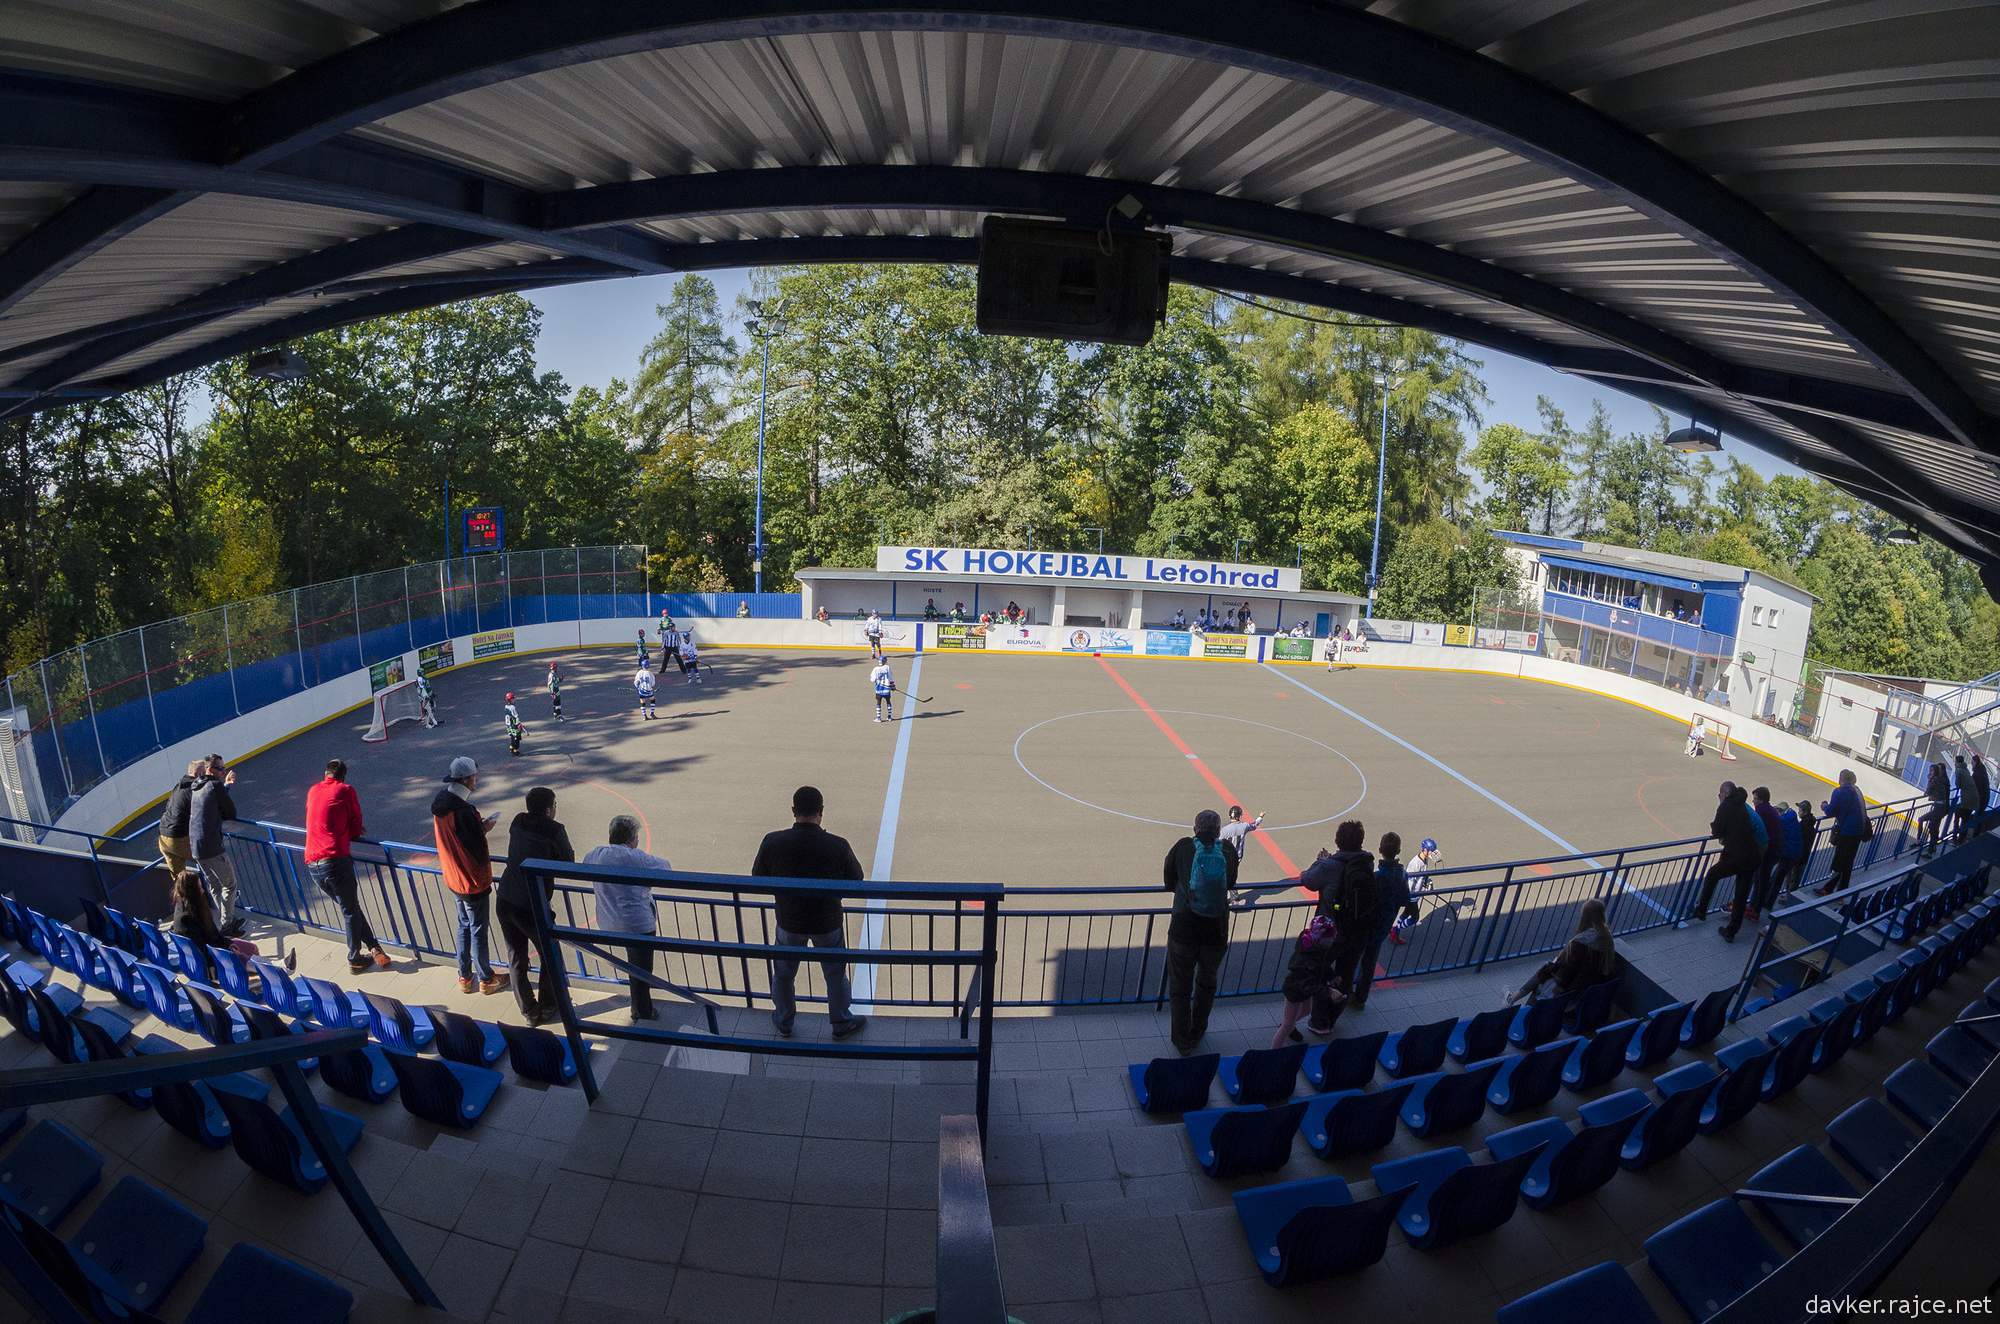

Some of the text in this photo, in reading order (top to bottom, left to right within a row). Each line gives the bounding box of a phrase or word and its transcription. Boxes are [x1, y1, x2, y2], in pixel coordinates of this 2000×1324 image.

[904, 548, 1279, 588] SK HOKEJBAL Letohrad
